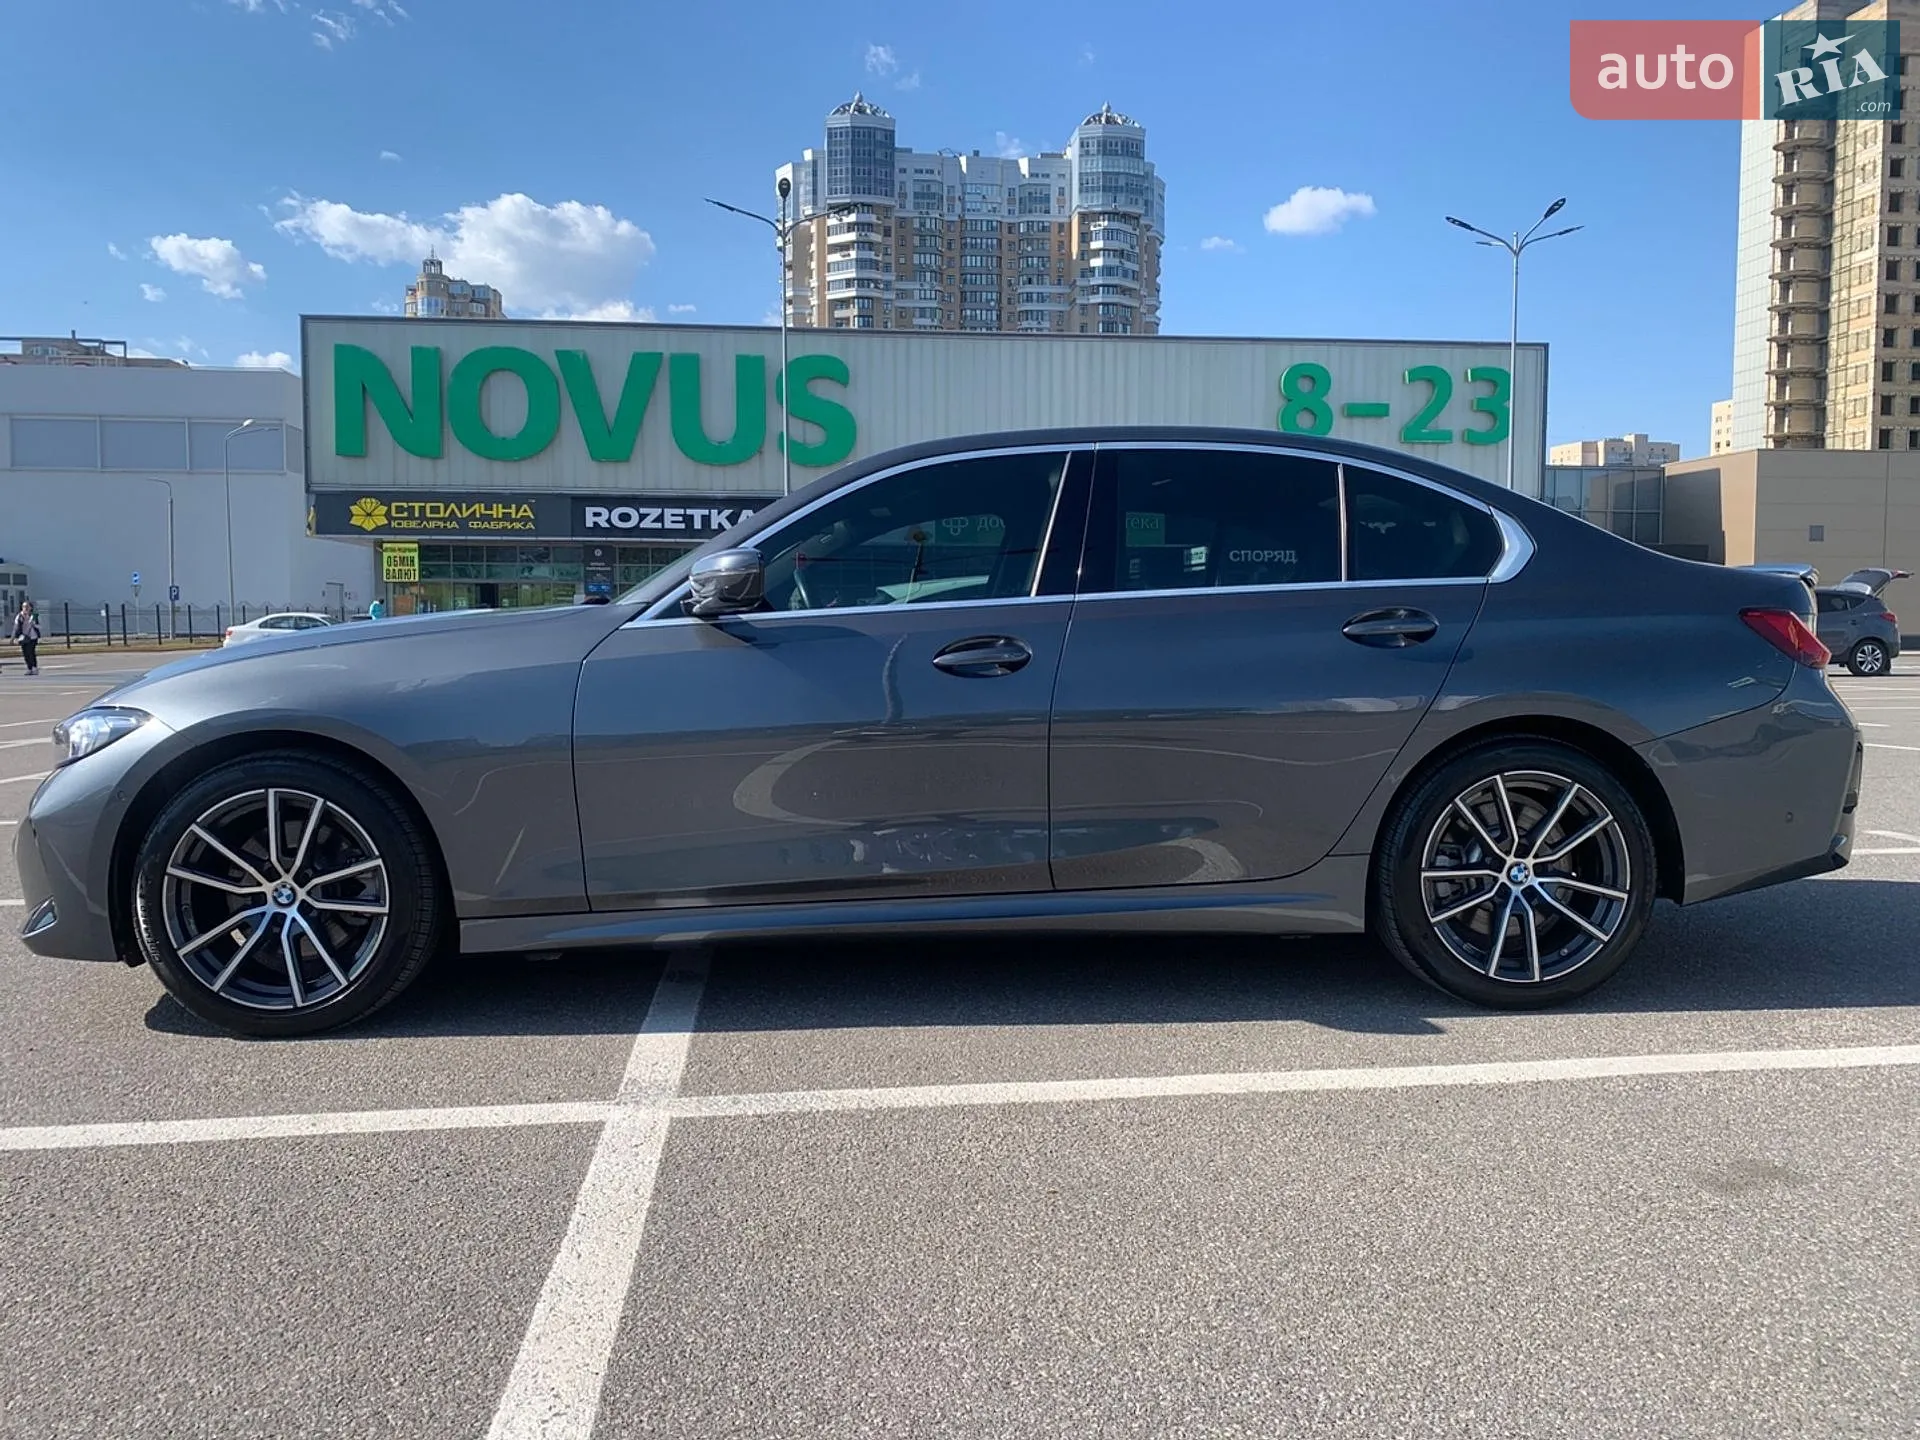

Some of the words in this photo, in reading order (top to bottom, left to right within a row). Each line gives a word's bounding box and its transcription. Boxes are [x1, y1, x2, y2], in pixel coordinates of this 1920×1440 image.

[333, 343, 858, 467] NOVUS
[391, 502, 534, 519] СТОЛИЧНА
[391, 520, 459, 529] ЮВЕЛІРНА
[468, 521, 535, 530] ФАБРИКА
